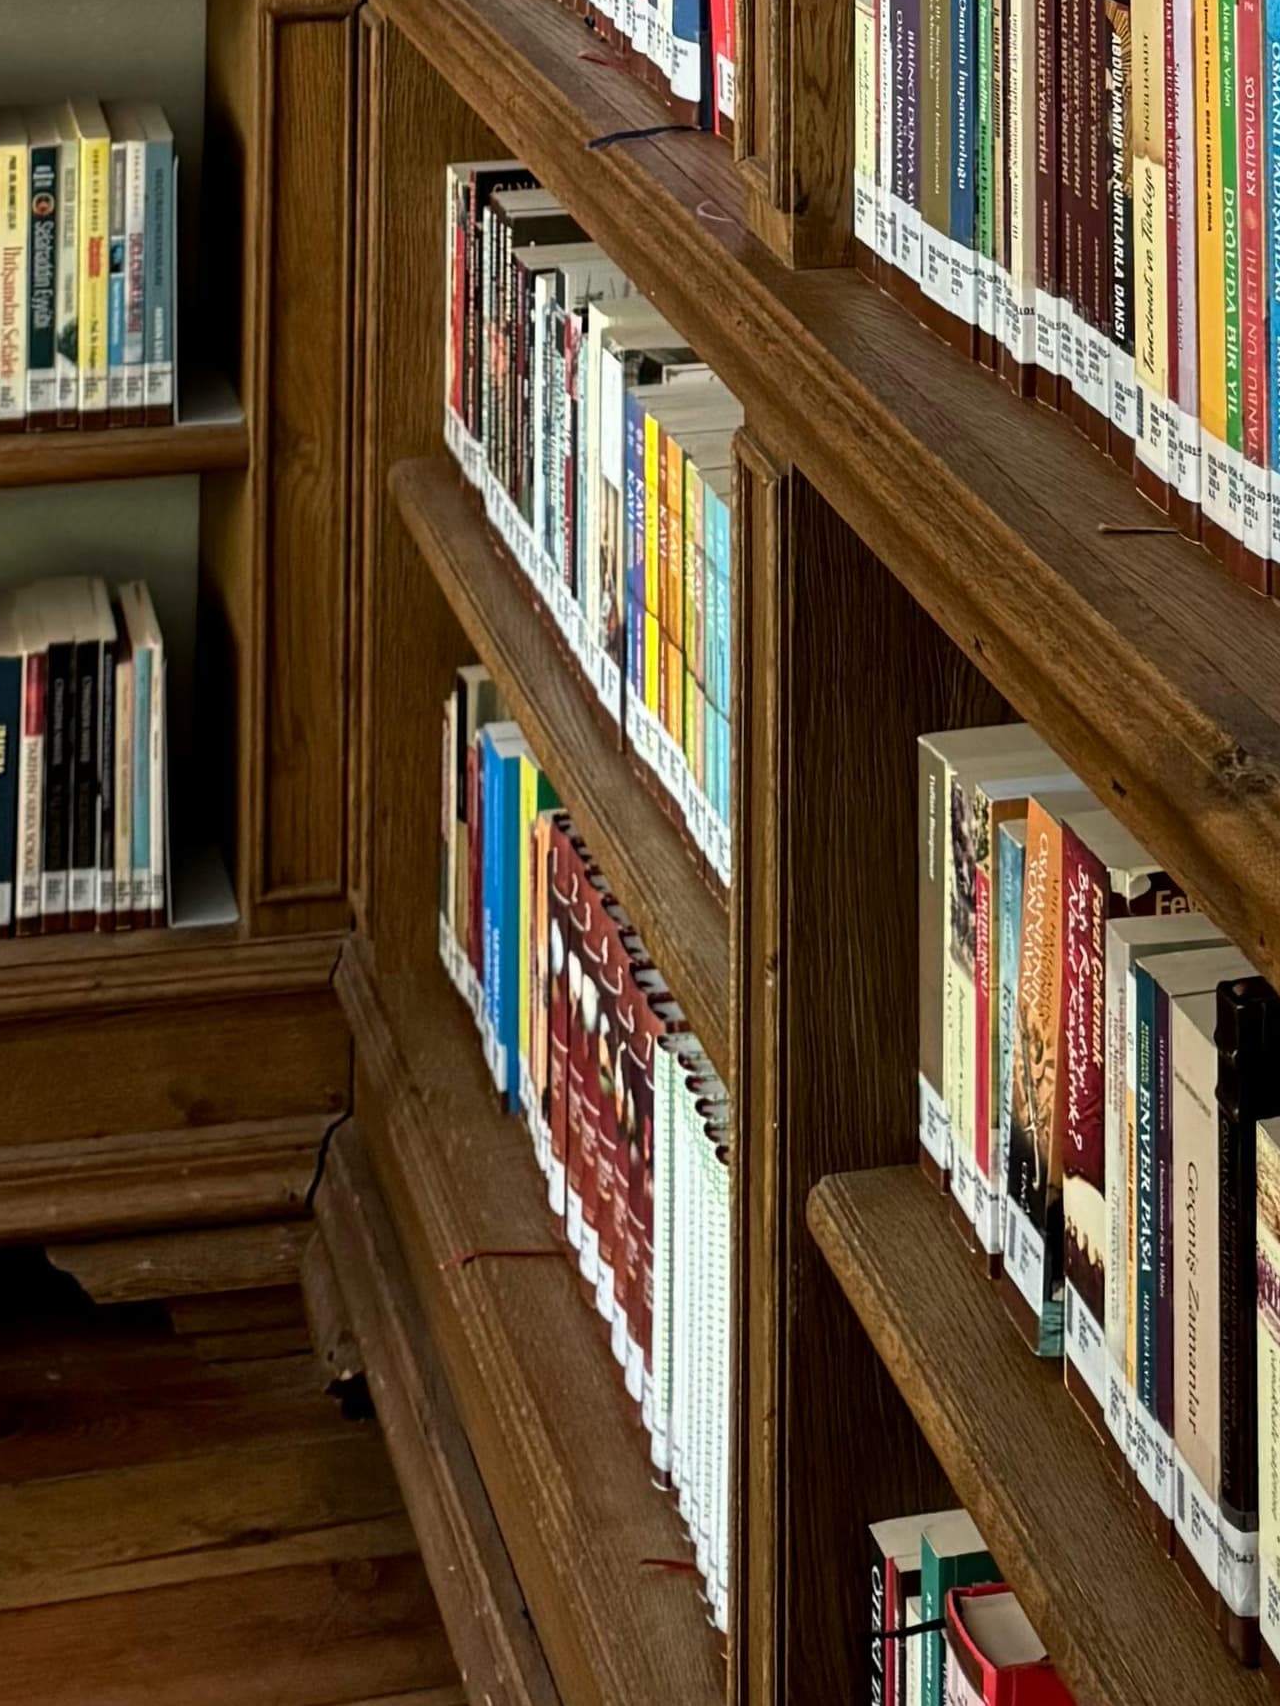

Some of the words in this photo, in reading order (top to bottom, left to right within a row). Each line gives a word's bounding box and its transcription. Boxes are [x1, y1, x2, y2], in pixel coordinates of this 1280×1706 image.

[626, 467, 635, 521] KAYI
[634, 477, 644, 532] KAYI
[660, 503, 669, 560] KAYI
[1139, 1085, 1151, 1174] ENVER
[1139, 1183, 1153, 1273] PAŞA
[1186, 1160, 1200, 1271] Geçmiş
[1185, 1277, 1200, 1438] Zamanlar
